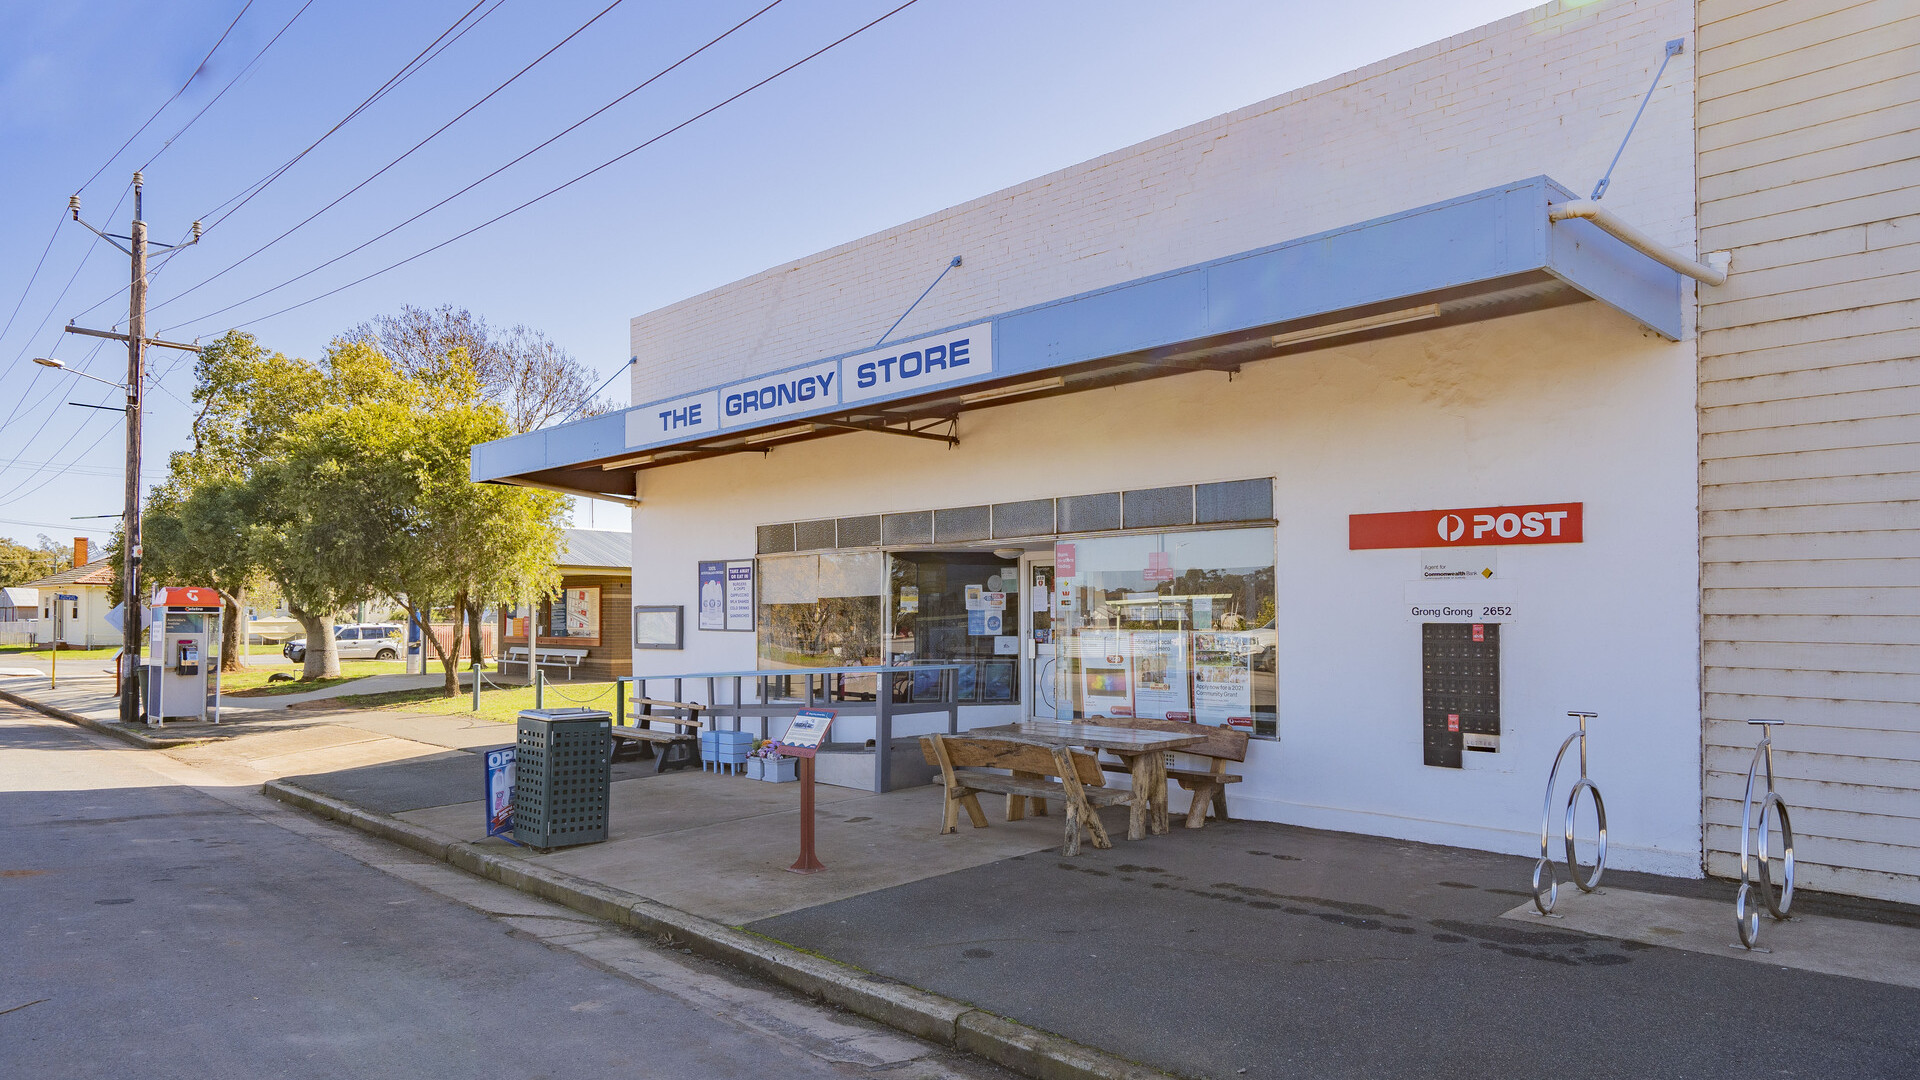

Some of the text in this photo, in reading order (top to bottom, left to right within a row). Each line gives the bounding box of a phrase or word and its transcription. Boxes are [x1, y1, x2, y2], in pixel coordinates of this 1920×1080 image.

[659, 338, 970, 431] THE GRONGY STORE
[1473, 511, 1568, 539] POST
[1411, 606, 1512, 618] Grong Grong 2652
[488, 750, 516, 768] OP
